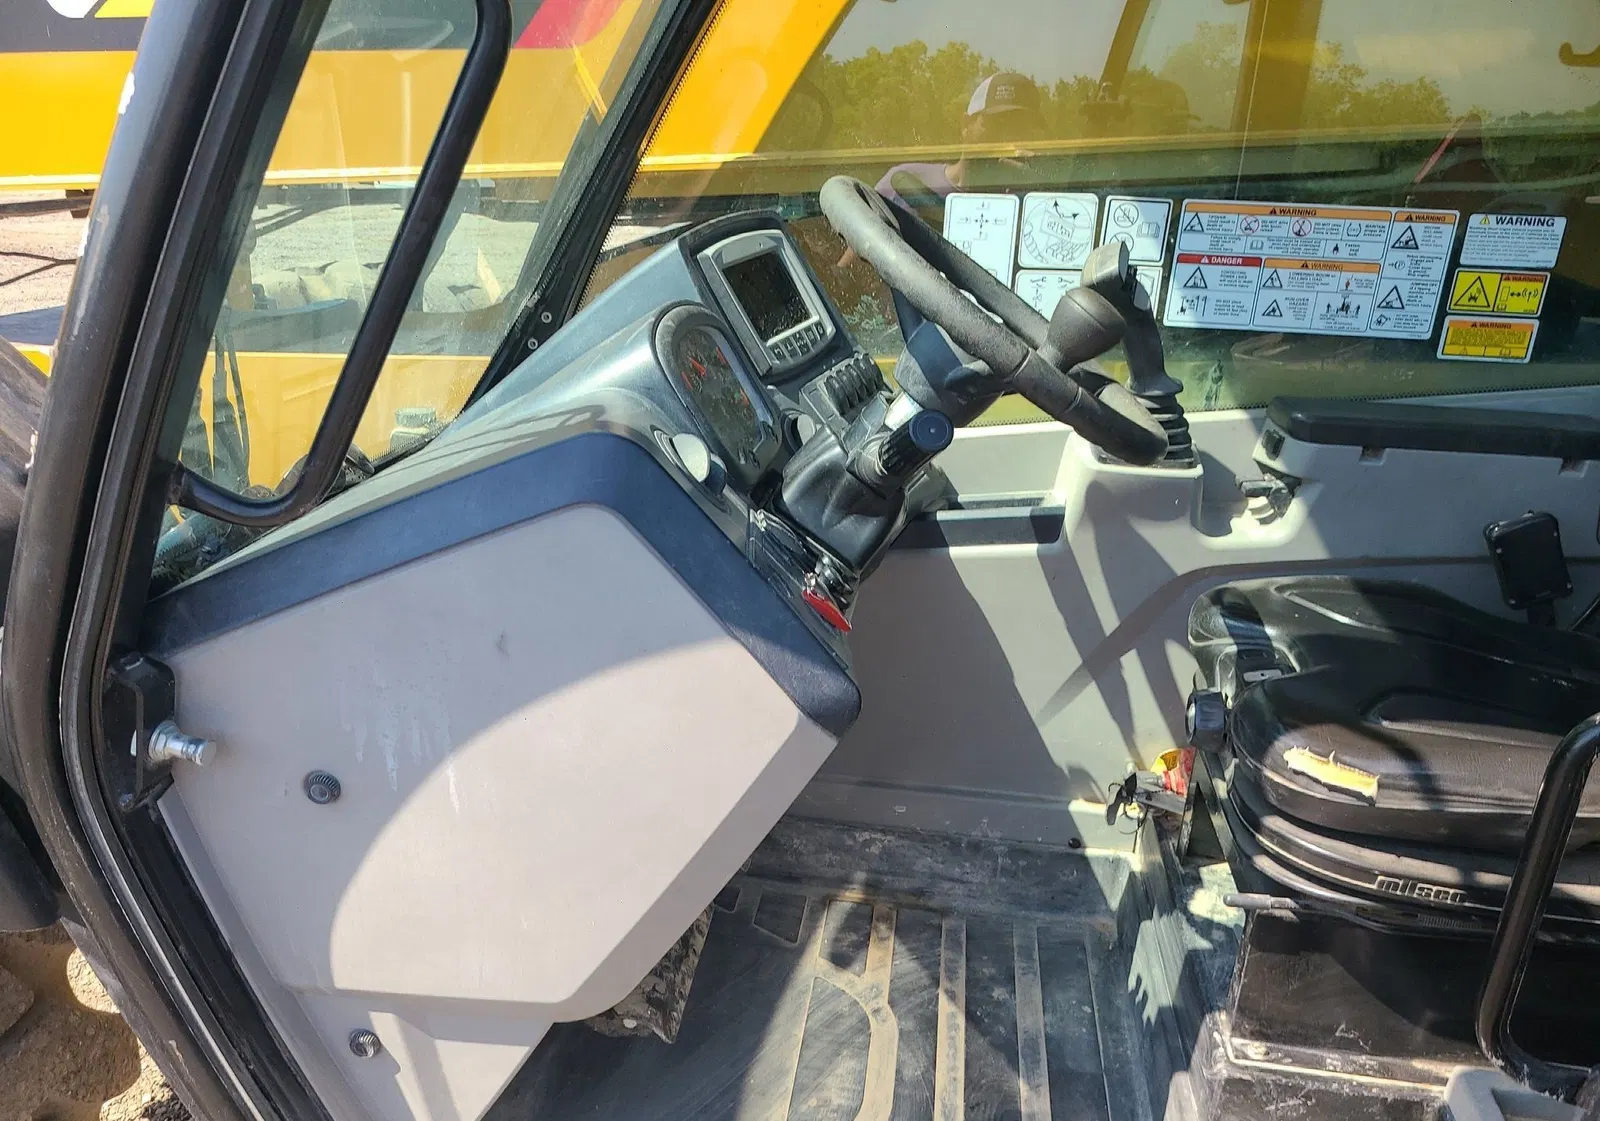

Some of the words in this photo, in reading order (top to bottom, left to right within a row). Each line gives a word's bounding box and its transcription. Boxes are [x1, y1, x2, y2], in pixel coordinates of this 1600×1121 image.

[1279, 207, 1317, 216] WARNING
[1415, 214, 1446, 222] WARNING
[1495, 216, 1555, 227] WARNING
[1211, 256, 1243, 265] DANGER
[1311, 262, 1343, 271] WARNING
[1512, 275, 1544, 283] WARNING
[1479, 321, 1512, 330] WARNING
